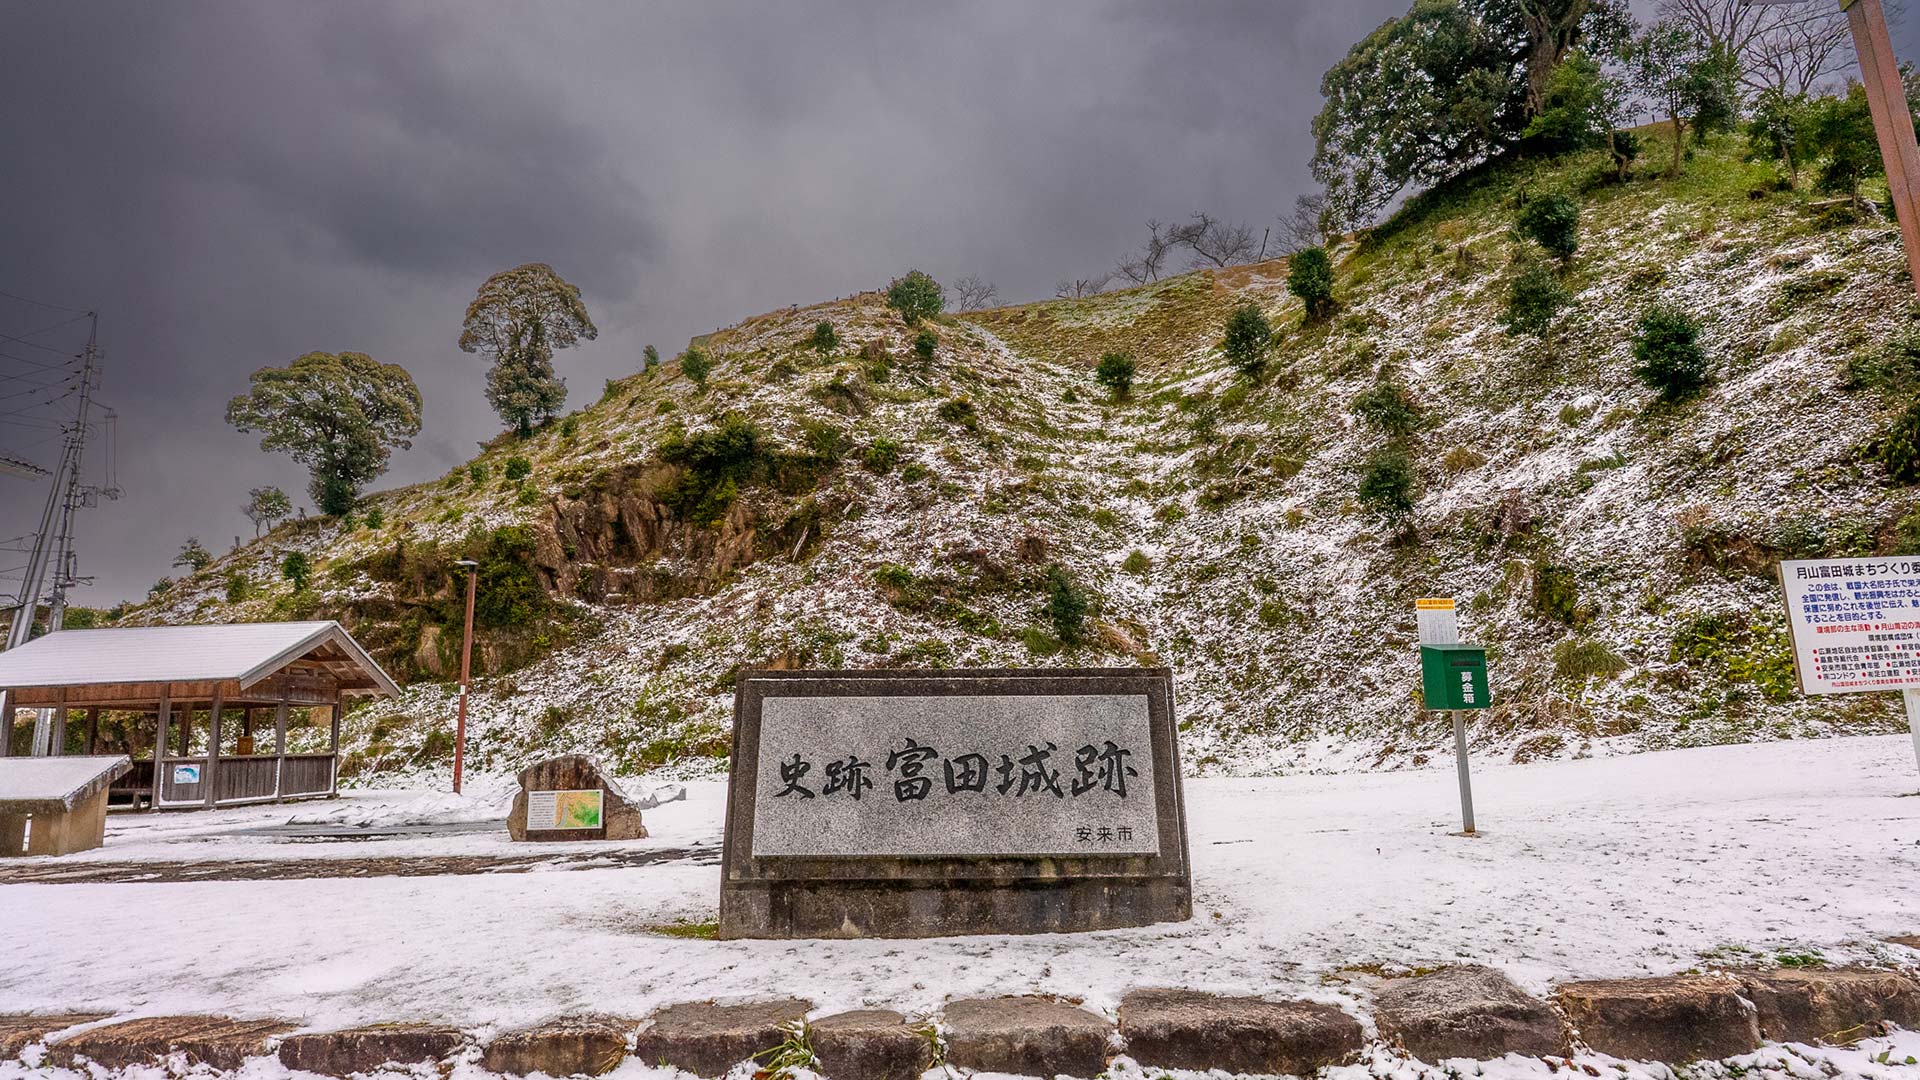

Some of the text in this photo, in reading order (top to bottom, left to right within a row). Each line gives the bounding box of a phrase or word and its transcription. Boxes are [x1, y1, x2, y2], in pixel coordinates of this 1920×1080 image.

[1805, 611, 1887, 624] することを目的とする。
[1076, 827, 1133, 842] 安来市
